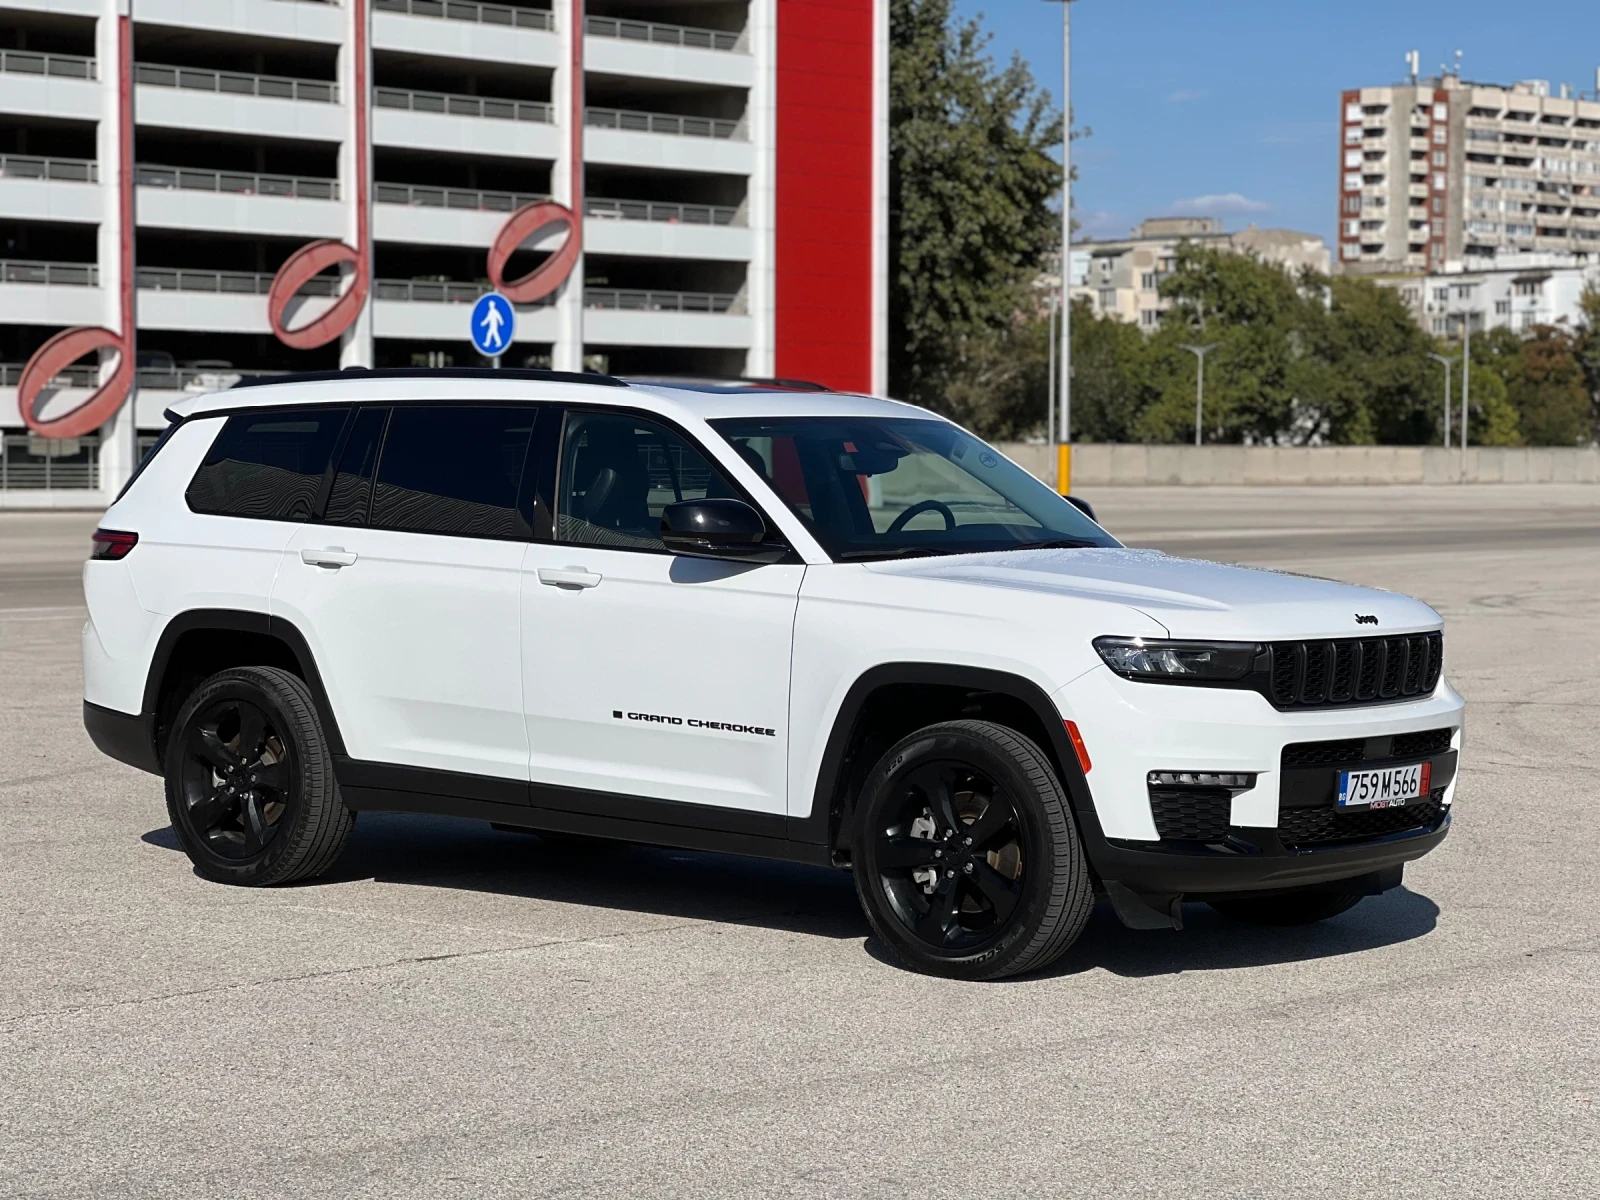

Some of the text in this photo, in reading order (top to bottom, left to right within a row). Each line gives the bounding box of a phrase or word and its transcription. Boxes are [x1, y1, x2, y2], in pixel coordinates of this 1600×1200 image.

[627, 712, 776, 737] GRAND CHEROKEE
[1338, 793, 1347, 801] BG
